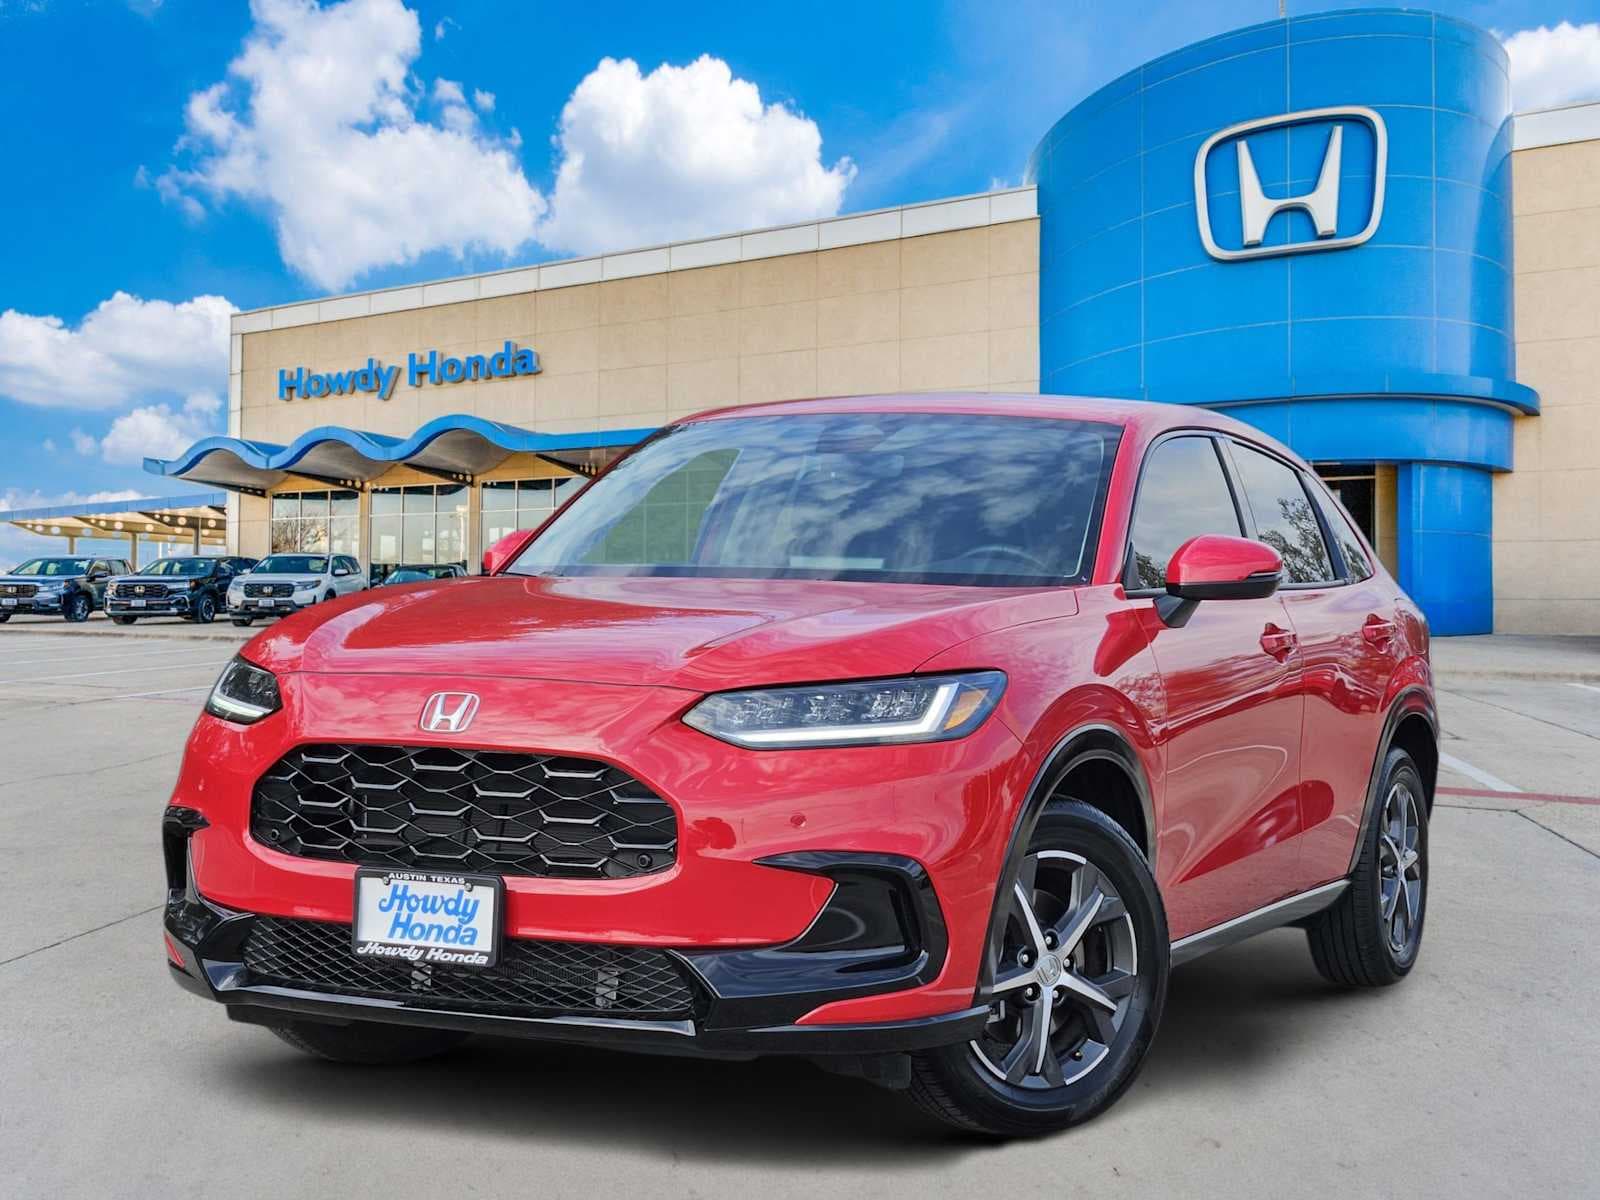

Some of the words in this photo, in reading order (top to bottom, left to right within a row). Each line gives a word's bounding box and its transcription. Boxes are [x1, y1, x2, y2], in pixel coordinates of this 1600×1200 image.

[278, 357, 402, 401] Howdy
[407, 340, 543, 388] Honda
[388, 872, 427, 882] AUSTIN
[429, 875, 465, 884] TEXAS
[378, 884, 480, 925] Howdy
[387, 912, 478, 946] Honda
[357, 942, 424, 961] Howdy
[425, 948, 489, 965] Honda
